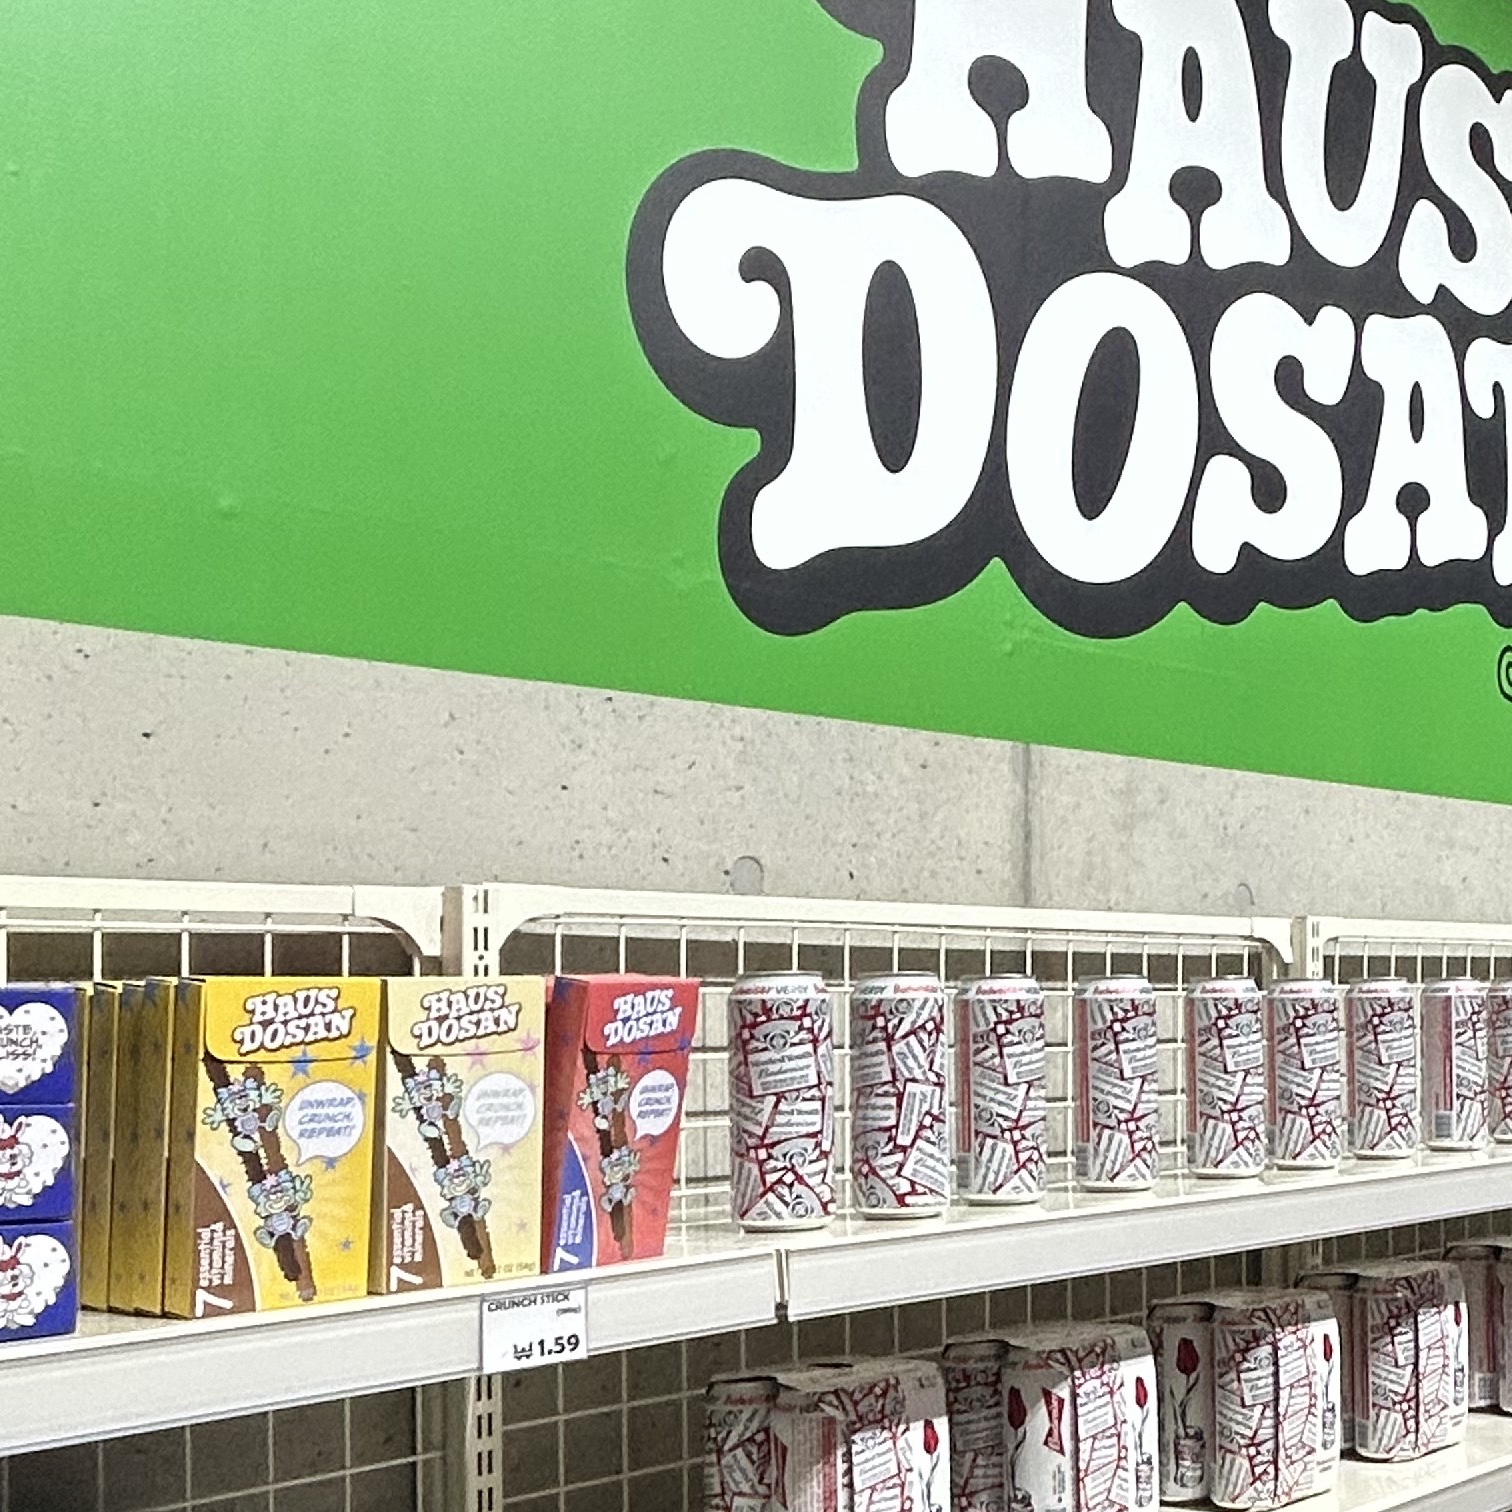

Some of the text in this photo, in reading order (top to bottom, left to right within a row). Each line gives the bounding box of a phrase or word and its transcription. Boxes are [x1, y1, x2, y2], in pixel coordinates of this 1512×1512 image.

[246, 987, 338, 1022] HAUS
[422, 984, 506, 1019] HAUS
[614, 988, 673, 1018] HAUS
[233, 1009, 354, 1054] DOSAN
[413, 1003, 520, 1048] DOSAN
[604, 1007, 682, 1046] DOSAN
[554, 1247, 579, 1272] 7
[390, 1265, 423, 1291] 7
[196, 1289, 233, 1317] 7
